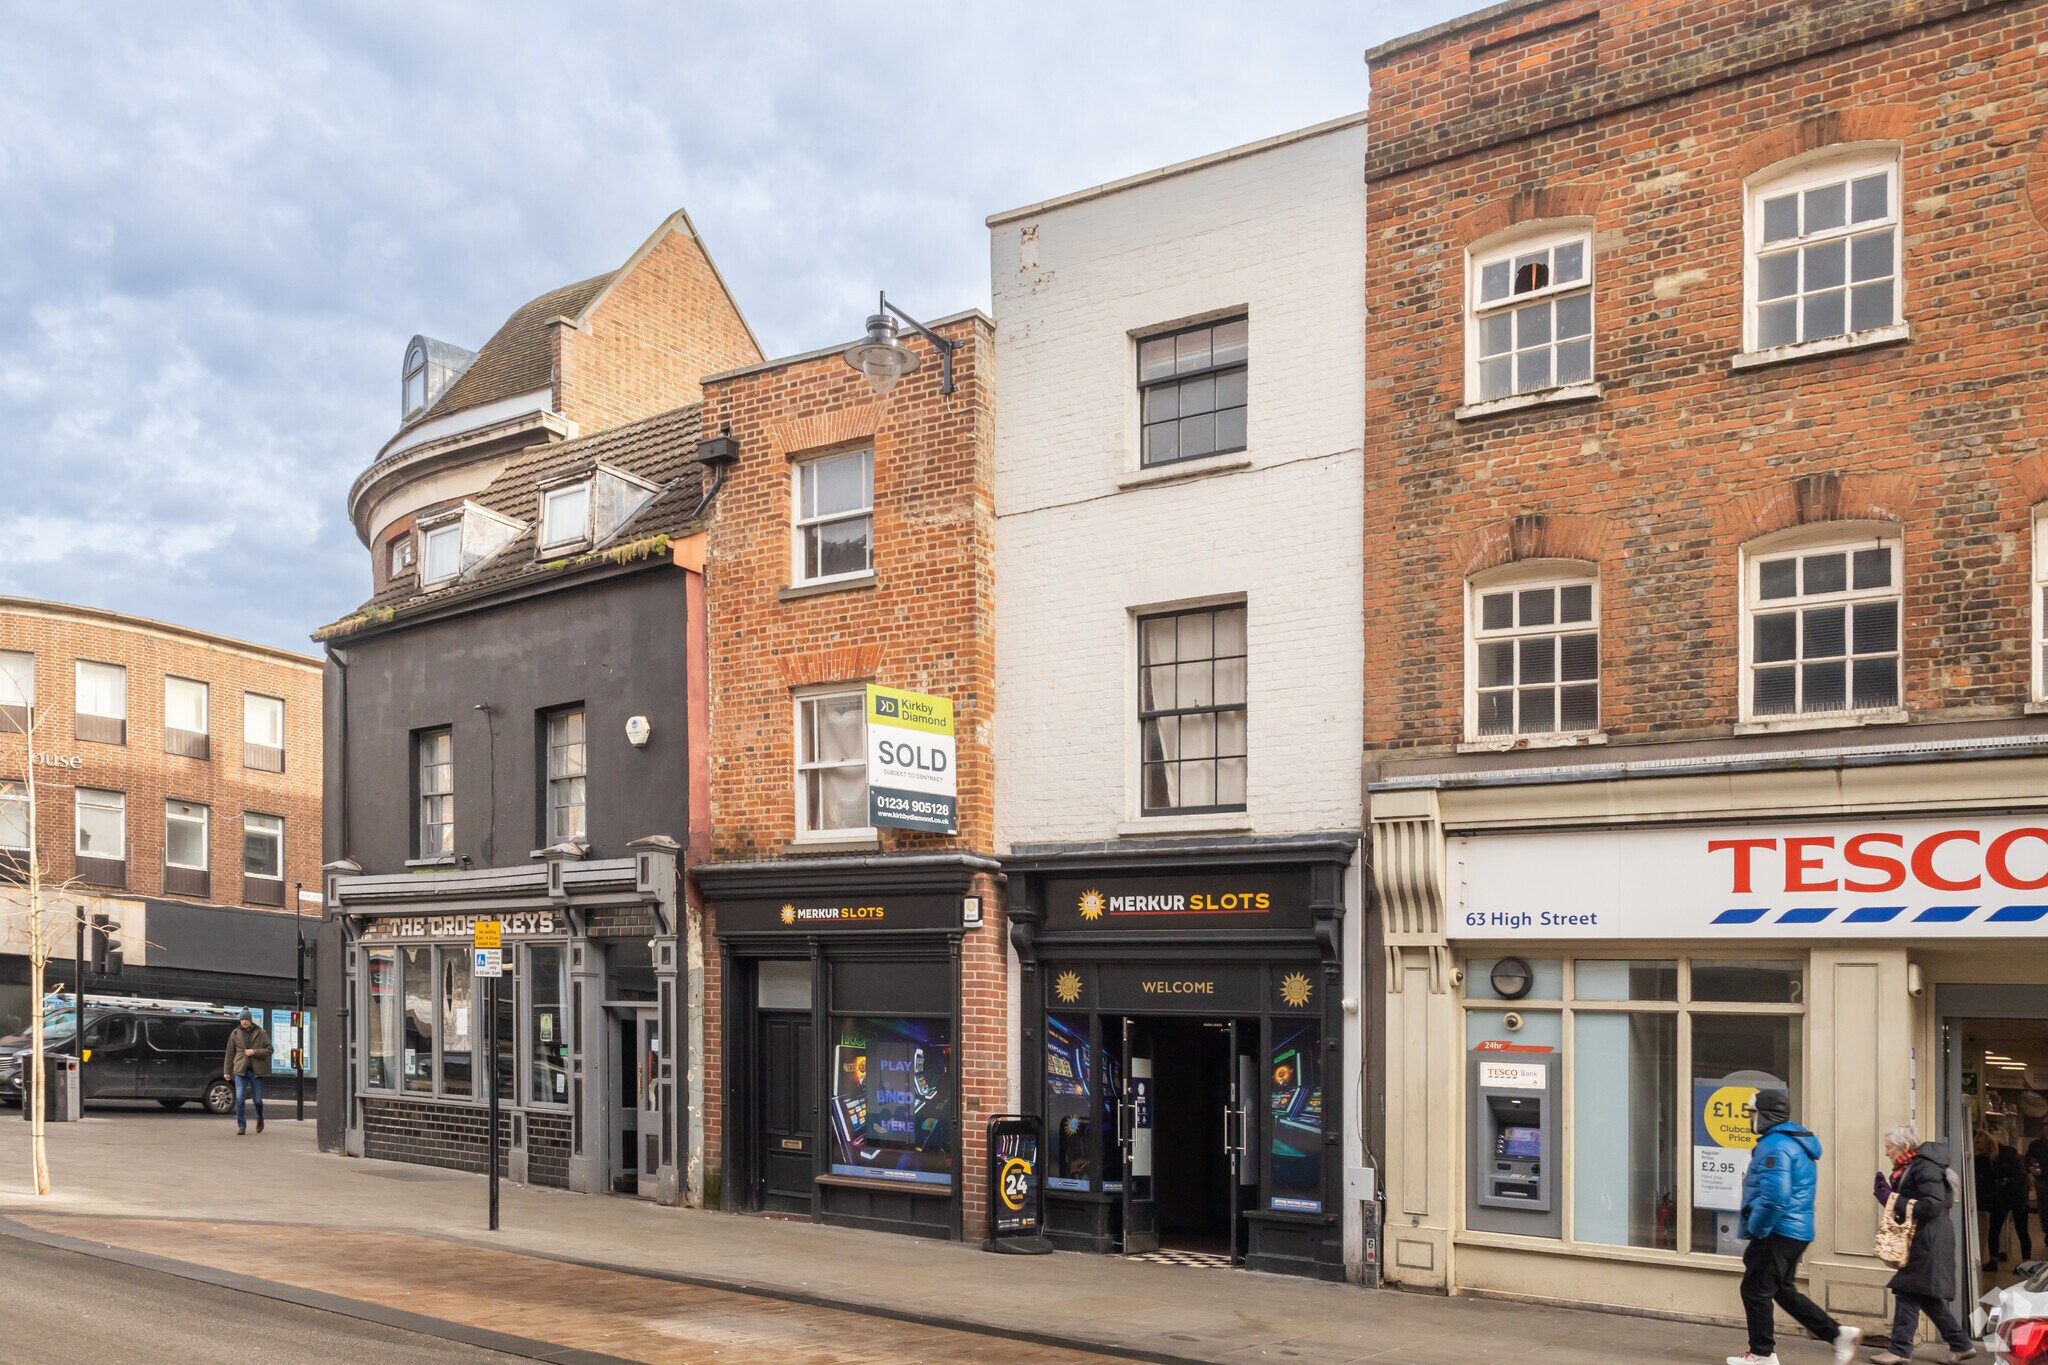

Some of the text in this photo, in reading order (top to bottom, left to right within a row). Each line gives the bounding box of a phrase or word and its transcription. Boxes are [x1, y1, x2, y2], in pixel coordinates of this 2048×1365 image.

[901, 699, 933, 715] Kirkby
[902, 711, 947, 727] Diamond
[879, 740, 947, 772] SOLD
[883, 769, 907, 777] SUBJECT
[916, 773, 943, 782] CONTRACT
[877, 796, 950, 816] 01234 905128
[877, 811, 950, 825] www.kirkbydiamond.co.uk
[1708, 827, 2048, 894] TESCO
[1110, 893, 1270, 912] MERKUR SLOTS
[797, 907, 884, 919] MERKUR SLOTS
[1465, 911, 1598, 929] 63 High Street
[390, 917, 425, 936] THE
[499, 911, 555, 934] KEYS
[1142, 981, 1214, 994] WELCOME
[880, 1060, 912, 1072] PLAY
[1488, 1068, 1518, 1076] TESCO
[876, 1089, 914, 1105] BINGO
[1713, 1101, 1752, 1119] £1.5
[881, 1119, 914, 1133] HERE
[1720, 1124, 1751, 1133] Clubca
[1728, 1134, 1751, 1143] Price
[1701, 1161, 1735, 1173] £2.95
[1006, 1174, 1028, 1195] 24
[1368, 1240, 1374, 1249] 6
